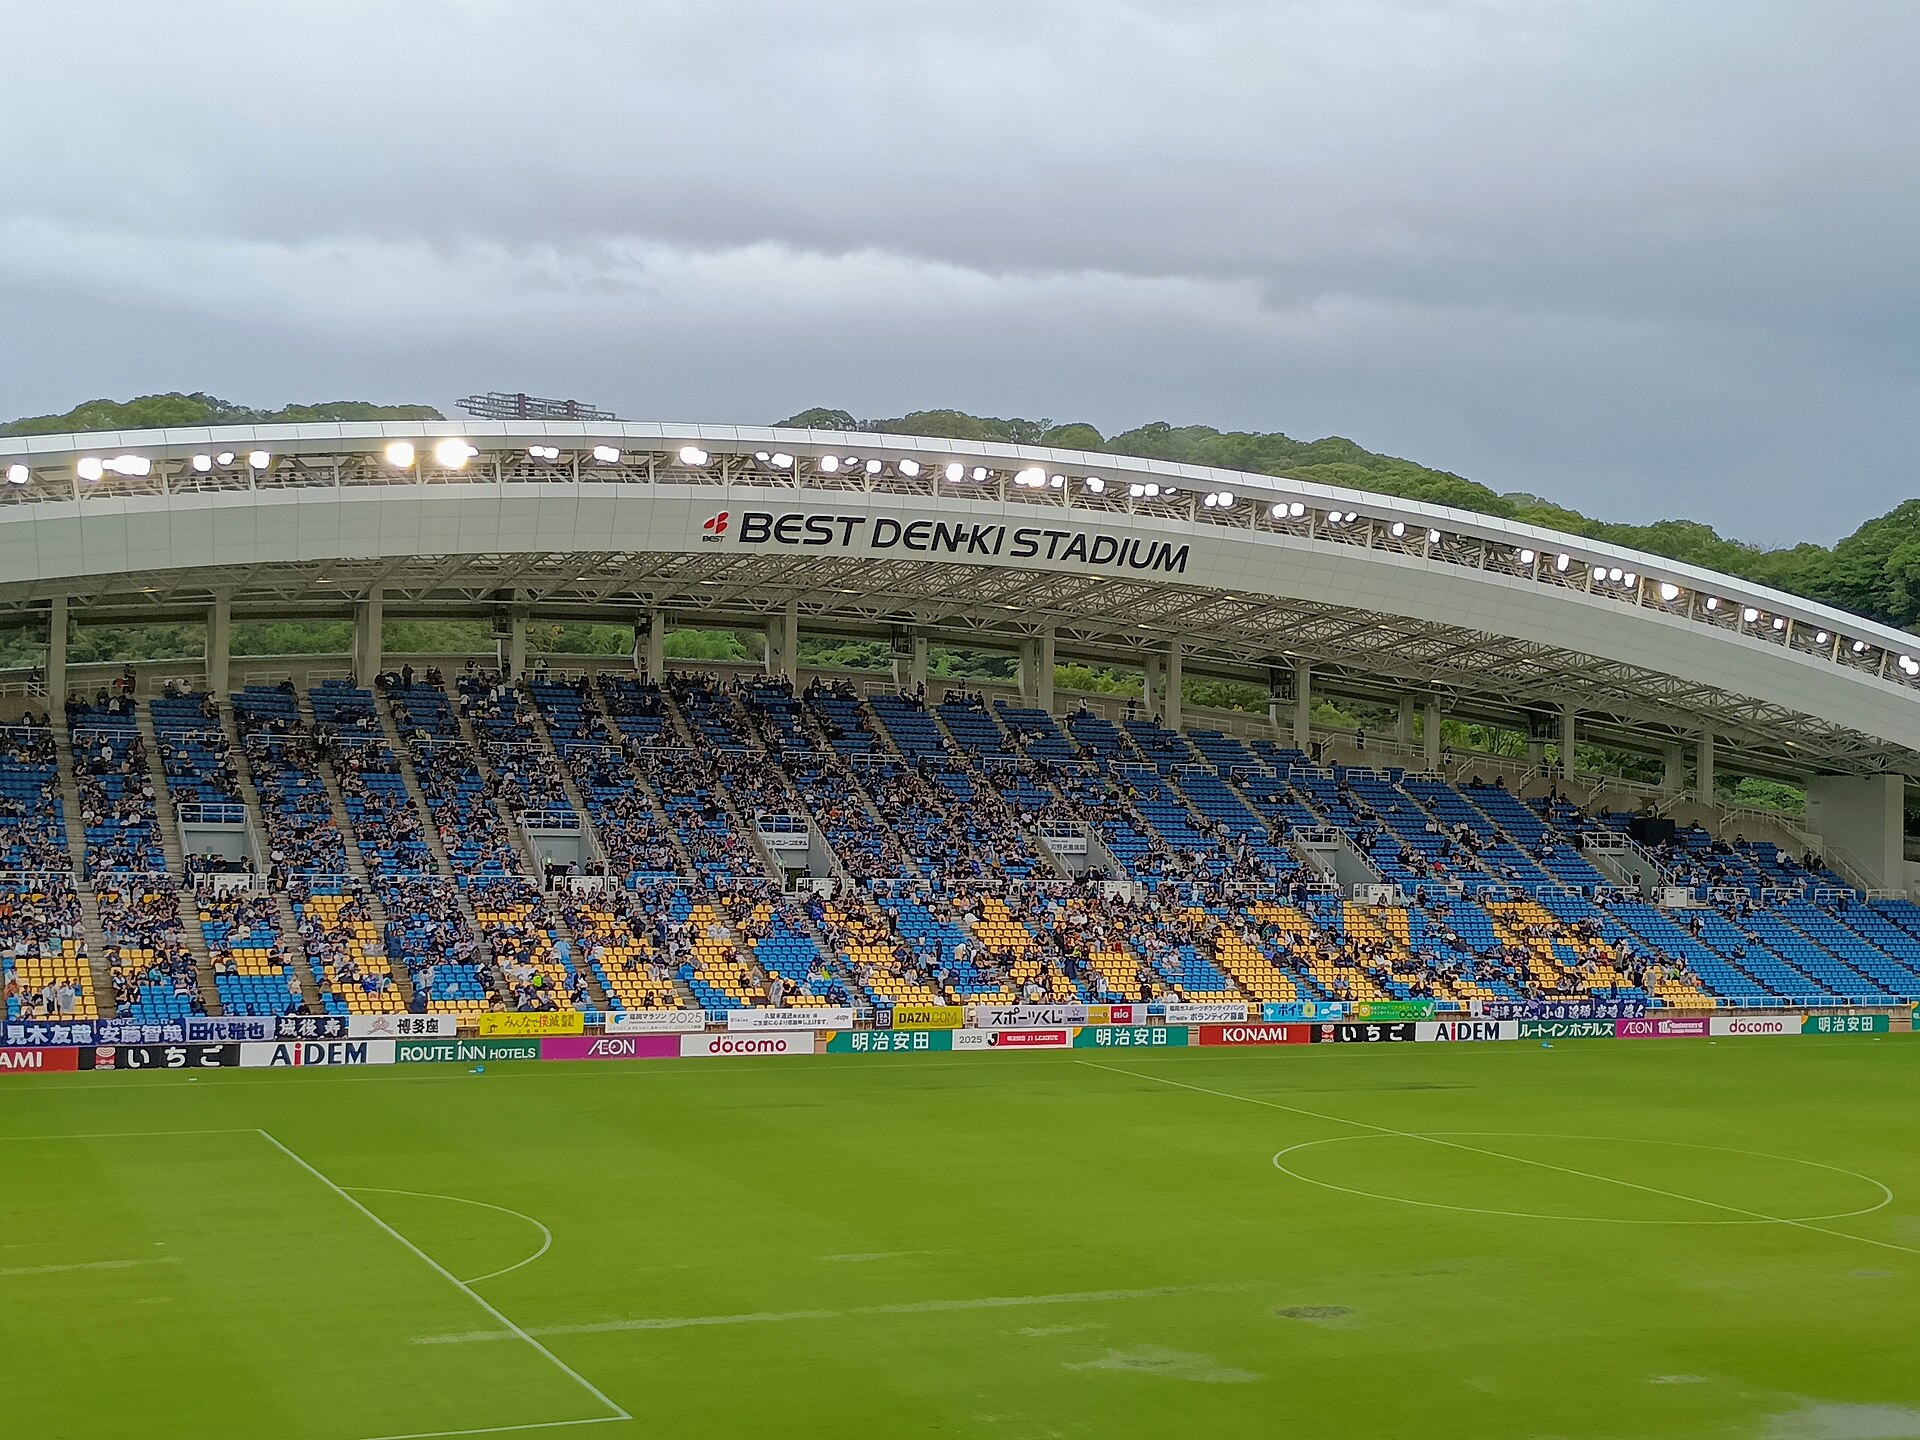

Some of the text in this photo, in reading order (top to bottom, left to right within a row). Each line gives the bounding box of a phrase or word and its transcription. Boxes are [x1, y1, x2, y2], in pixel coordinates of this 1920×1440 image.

[739, 512, 866, 546] BEST
[1010, 528, 1190, 573] STADIUM
[669, 1012, 702, 1024] 2025
[990, 1007, 1063, 1025] スポーツくじ
[1818, 1017, 1873, 1032] 明治安田
[7, 1025, 93, 1044] 見木友哉
[100, 1024, 183, 1042] 安藤智哉
[189, 1022, 264, 1040] 田代雅也
[397, 1018, 439, 1034] 博多座
[1222, 1028, 1288, 1042] KONAMI
[1342, 1024, 1404, 1042] いちご
[1729, 1019, 1783, 1033] docomo
[708, 1036, 787, 1054] docomo
[852, 1031, 929, 1051] 明治安田
[959, 1036, 982, 1044] 2025
[1095, 1028, 1167, 1046] 明治安田
[128, 1045, 223, 1068] いちご
[400, 1047, 454, 1061] ROUTE
[489, 1047, 536, 1059] HOTELS
